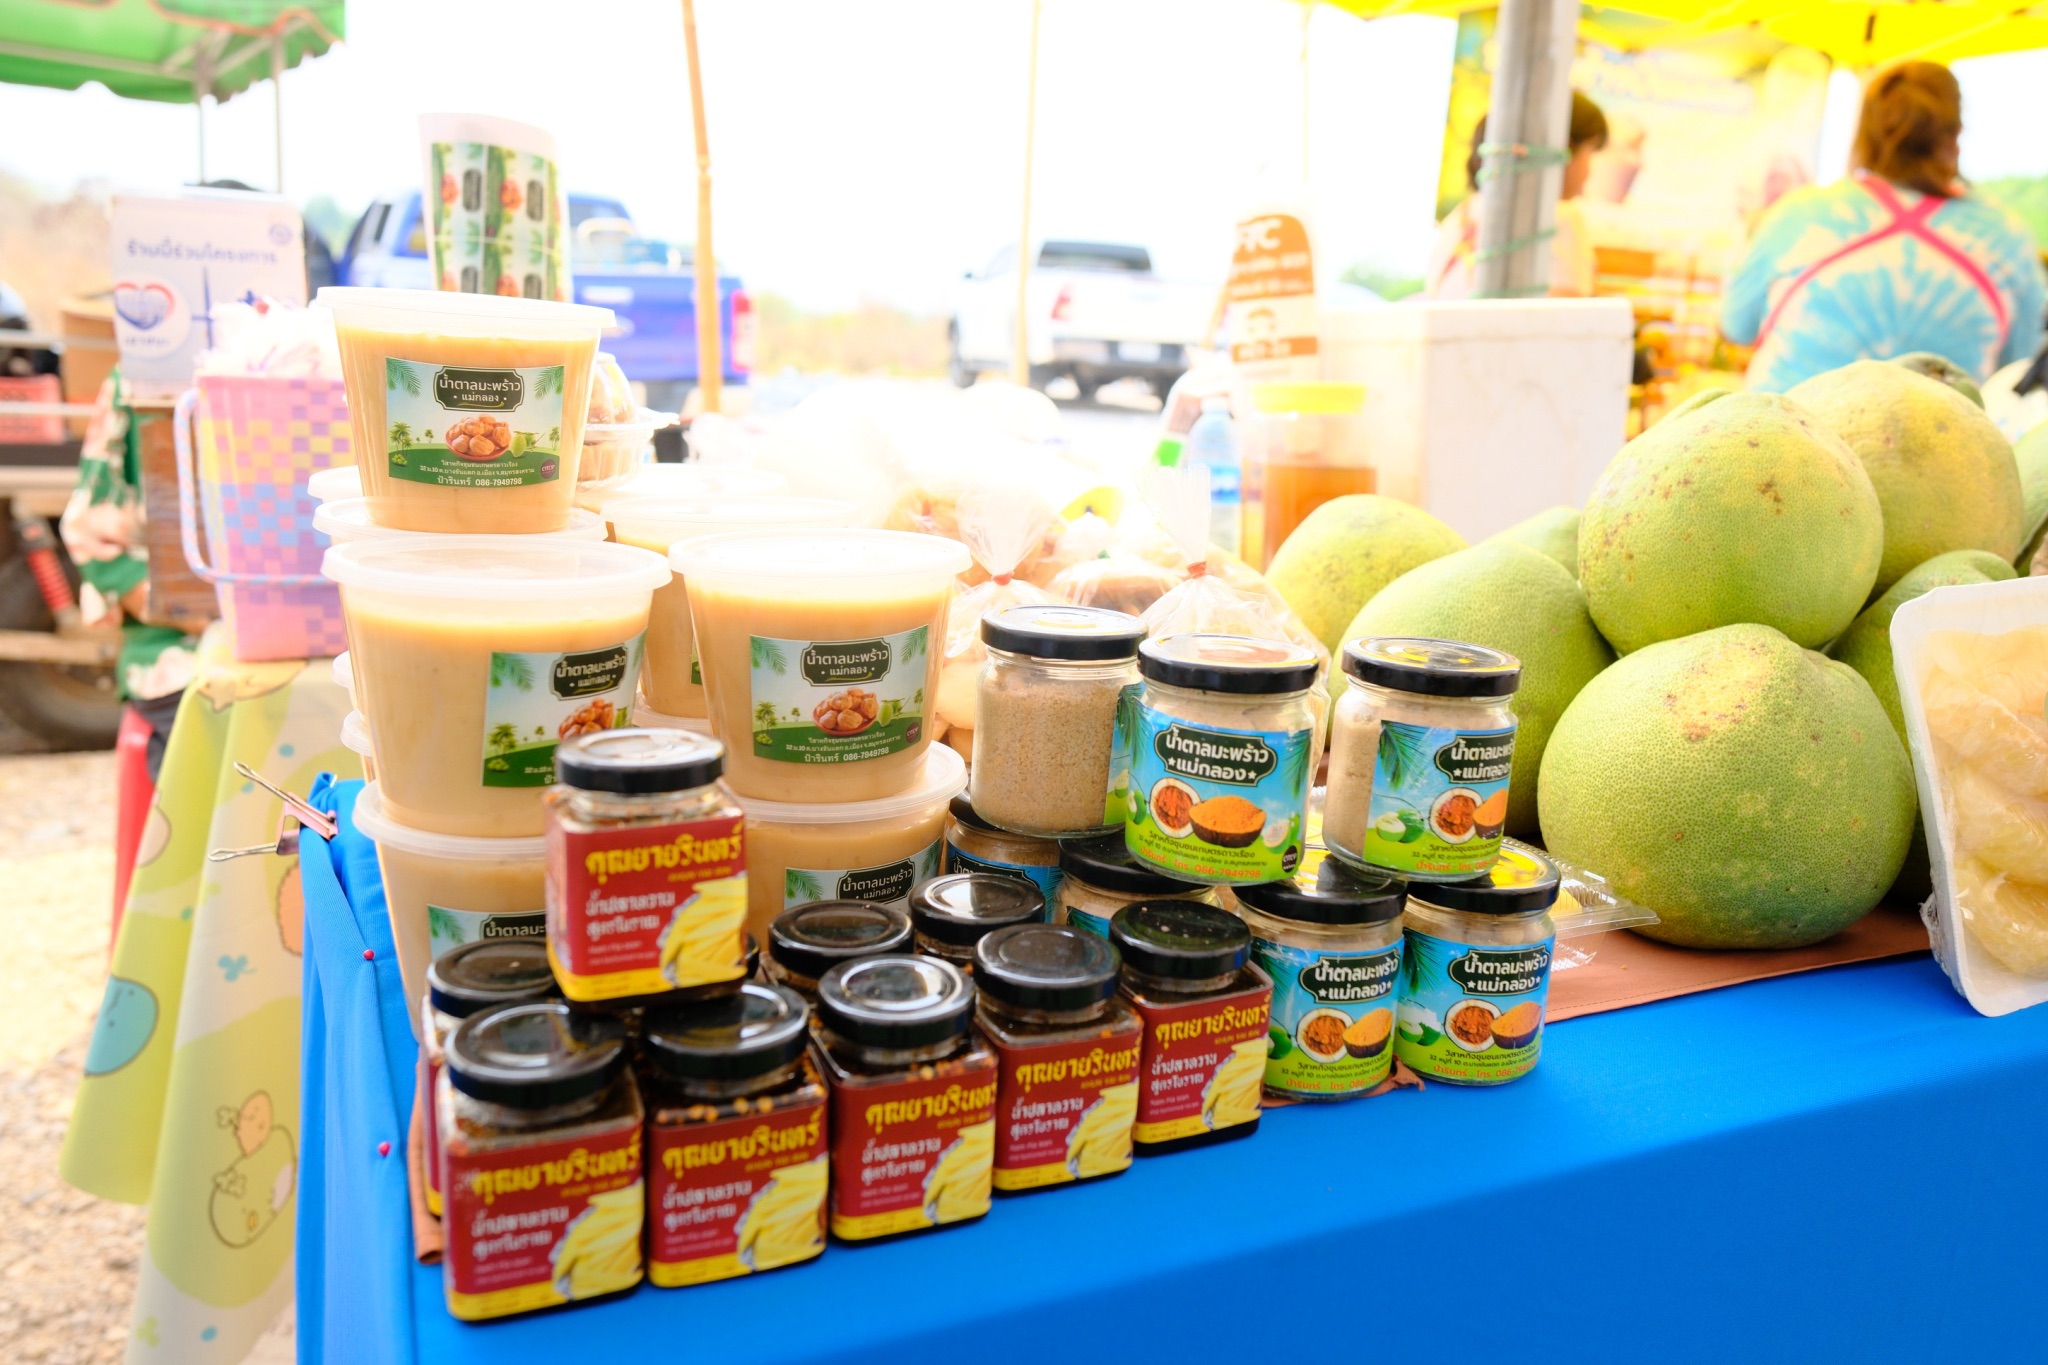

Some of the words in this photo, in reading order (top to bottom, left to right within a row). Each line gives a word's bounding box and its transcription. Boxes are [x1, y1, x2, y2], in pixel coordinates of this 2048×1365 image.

[439, 373, 521, 392] น้ำตาลมะพร้าว
[461, 392, 499, 403] แม่กลอง
[475, 477, 522, 487] 086-7949798
[806, 649, 888, 666] น้ำตาลมะพร้าว
[829, 664, 868, 676] แม่กลอง
[577, 674, 611, 687] แม่กลอง
[843, 746, 890, 761] 086-7949798
[1165, 727, 1269, 764] น้ำตาลมะพร้าว
[1176, 757, 1247, 781] แม่กลอง
[585, 821, 743, 885] คุณยายรินทร์
[1174, 858, 1190, 871] โทร
[1194, 864, 1262, 879] 086-7949798
[842, 868, 914, 892] น้ำตาลมะพร้าว
[863, 885, 896, 900] แม่กลอง
[485, 921, 545, 937] น้ำตาลมะ
[1315, 956, 1398, 982] น้ำตาลมะพร้าว
[1464, 952, 1548, 975] น้ำตาลมะพร้าว
[1328, 982, 1387, 1000] แม่กลอง
[1476, 977, 1536, 992] แม่กลอง
[1155, 990, 1272, 1050] คุณยายรินทร์
[1015, 1032, 1143, 1093] คุณยายรินทร์
[1151, 1052, 1218, 1076] น้ำปลาหวาน
[1476, 1069, 1491, 1078] โทร
[662, 1105, 825, 1179] คุณยายรินทร์
